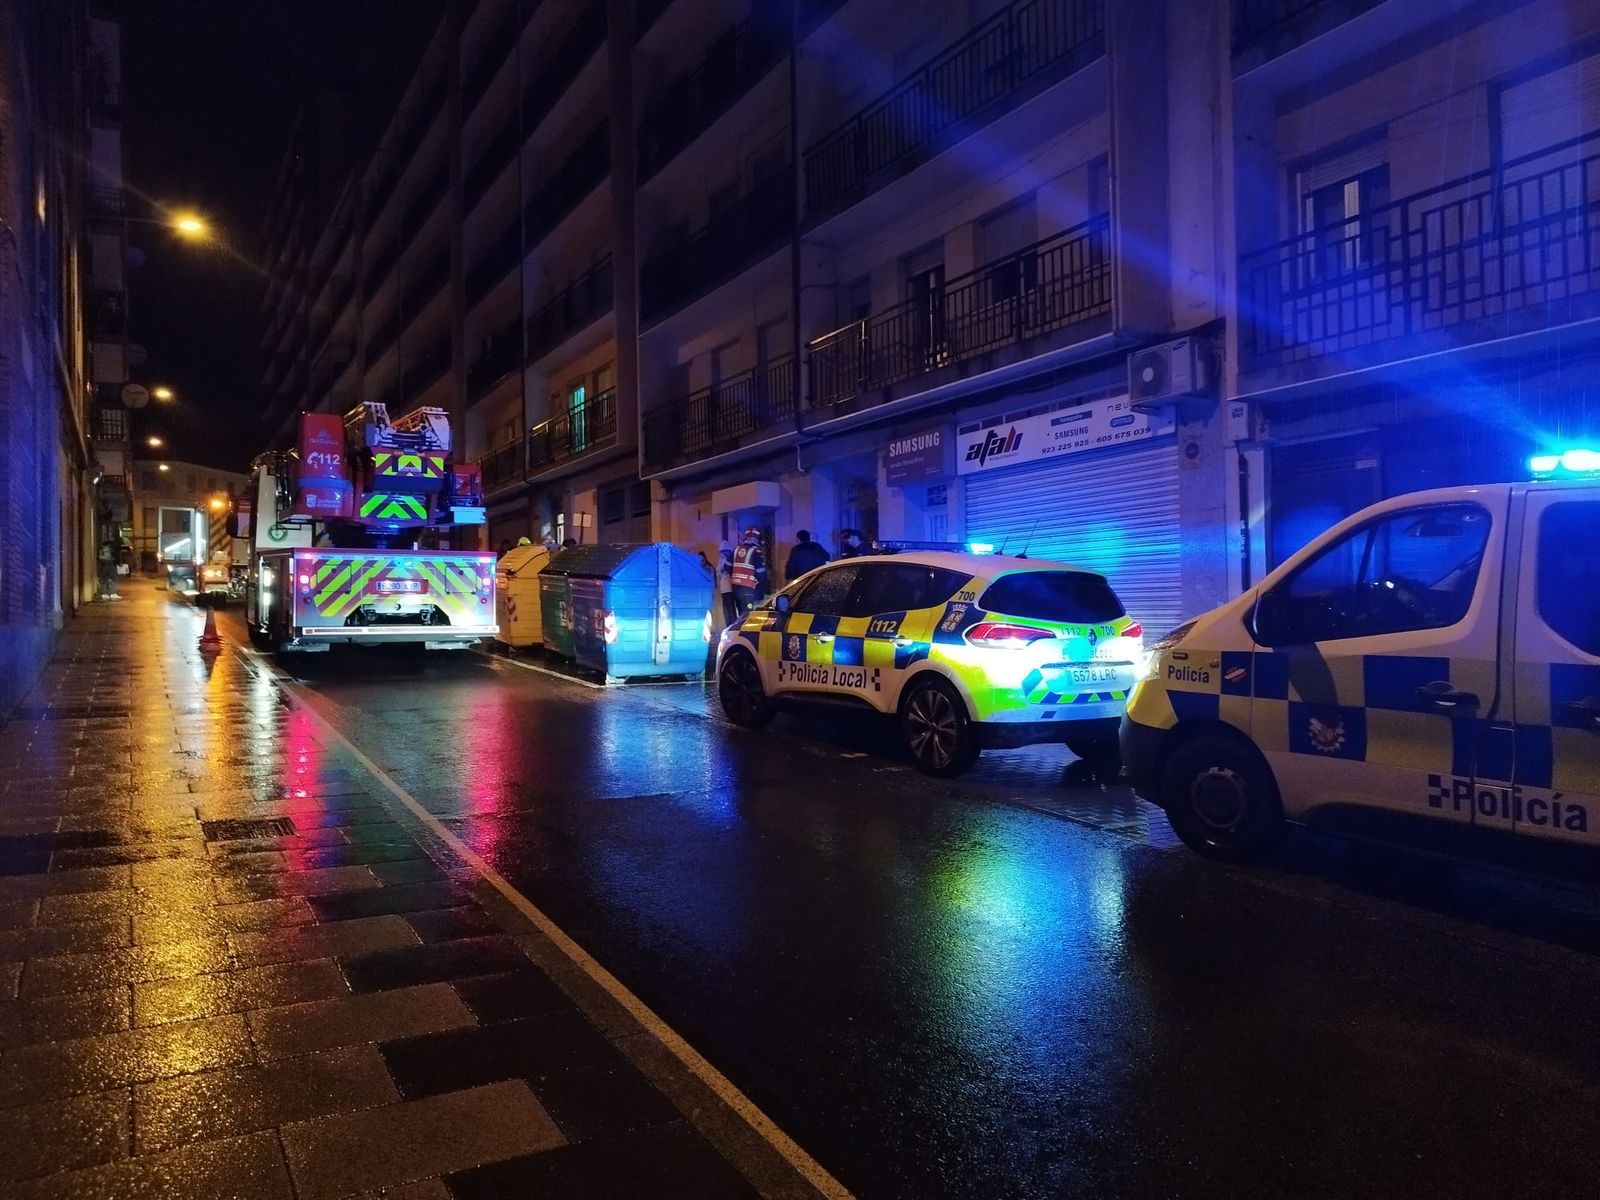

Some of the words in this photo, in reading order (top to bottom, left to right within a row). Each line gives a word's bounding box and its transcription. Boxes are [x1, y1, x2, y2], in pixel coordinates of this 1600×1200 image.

[1054, 426, 1089, 440] SAMSUNG
[1057, 443, 1072, 451] 225
[1074, 440, 1089, 448] 925
[1096, 434, 1112, 443] 605
[1114, 430, 1131, 439] 675
[1133, 427, 1151, 435] 039
[889, 432, 940, 457] SAMSUNG
[317, 453, 340, 465] 112
[958, 591, 976, 601] 700
[875, 619, 895, 633] 112
[1066, 627, 1082, 635] 112
[1101, 626, 1115, 636] 700
[790, 662, 828, 684] Policía
[832, 666, 867, 688] Local
[1073, 670, 1097, 682] 5578
[1100, 669, 1116, 680] LRC
[1168, 665, 1210, 683] Policía
[1452, 779, 1588, 832] Policía
